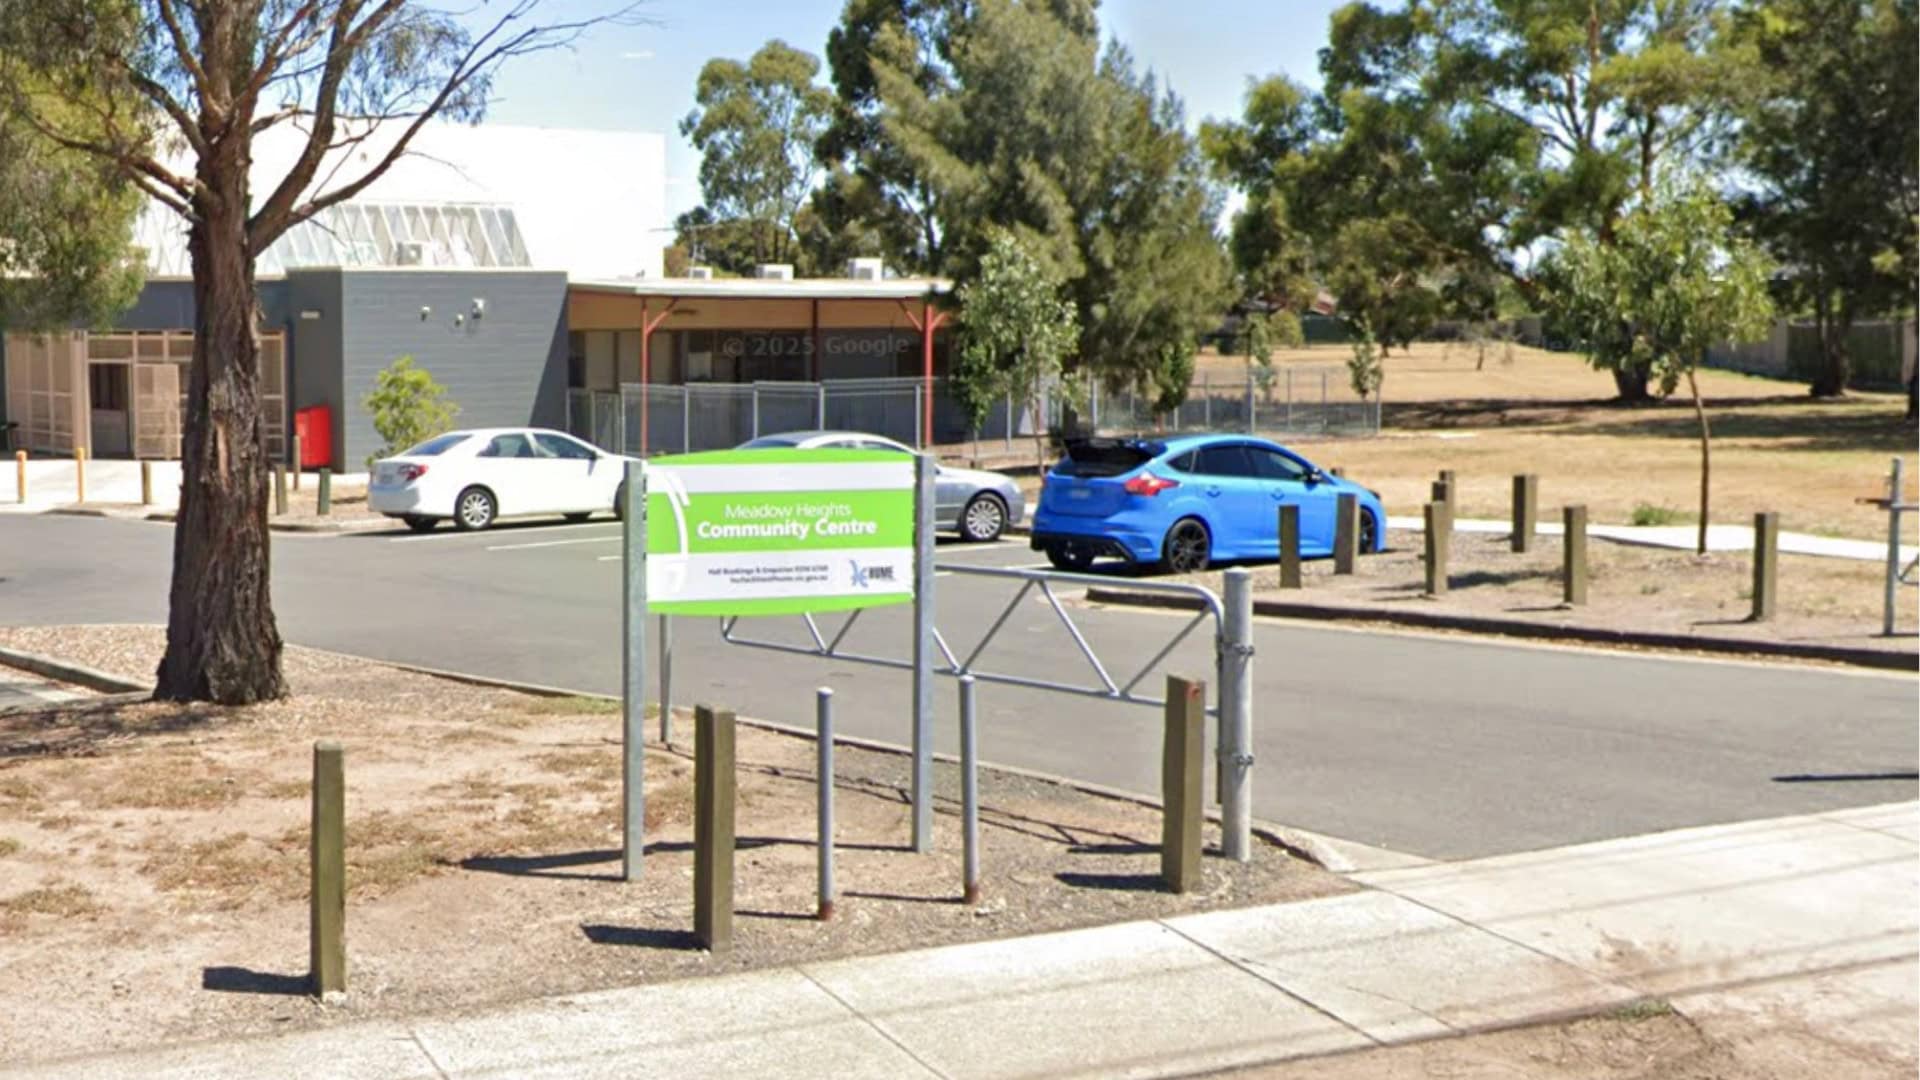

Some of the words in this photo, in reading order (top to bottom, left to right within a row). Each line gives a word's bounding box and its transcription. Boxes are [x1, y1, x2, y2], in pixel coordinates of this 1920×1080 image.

[724, 503, 792, 519] Meadow
[796, 502, 852, 519] Heights
[696, 519, 809, 540] Community
[815, 518, 877, 536] Centre
[868, 566, 894, 579] HUME
